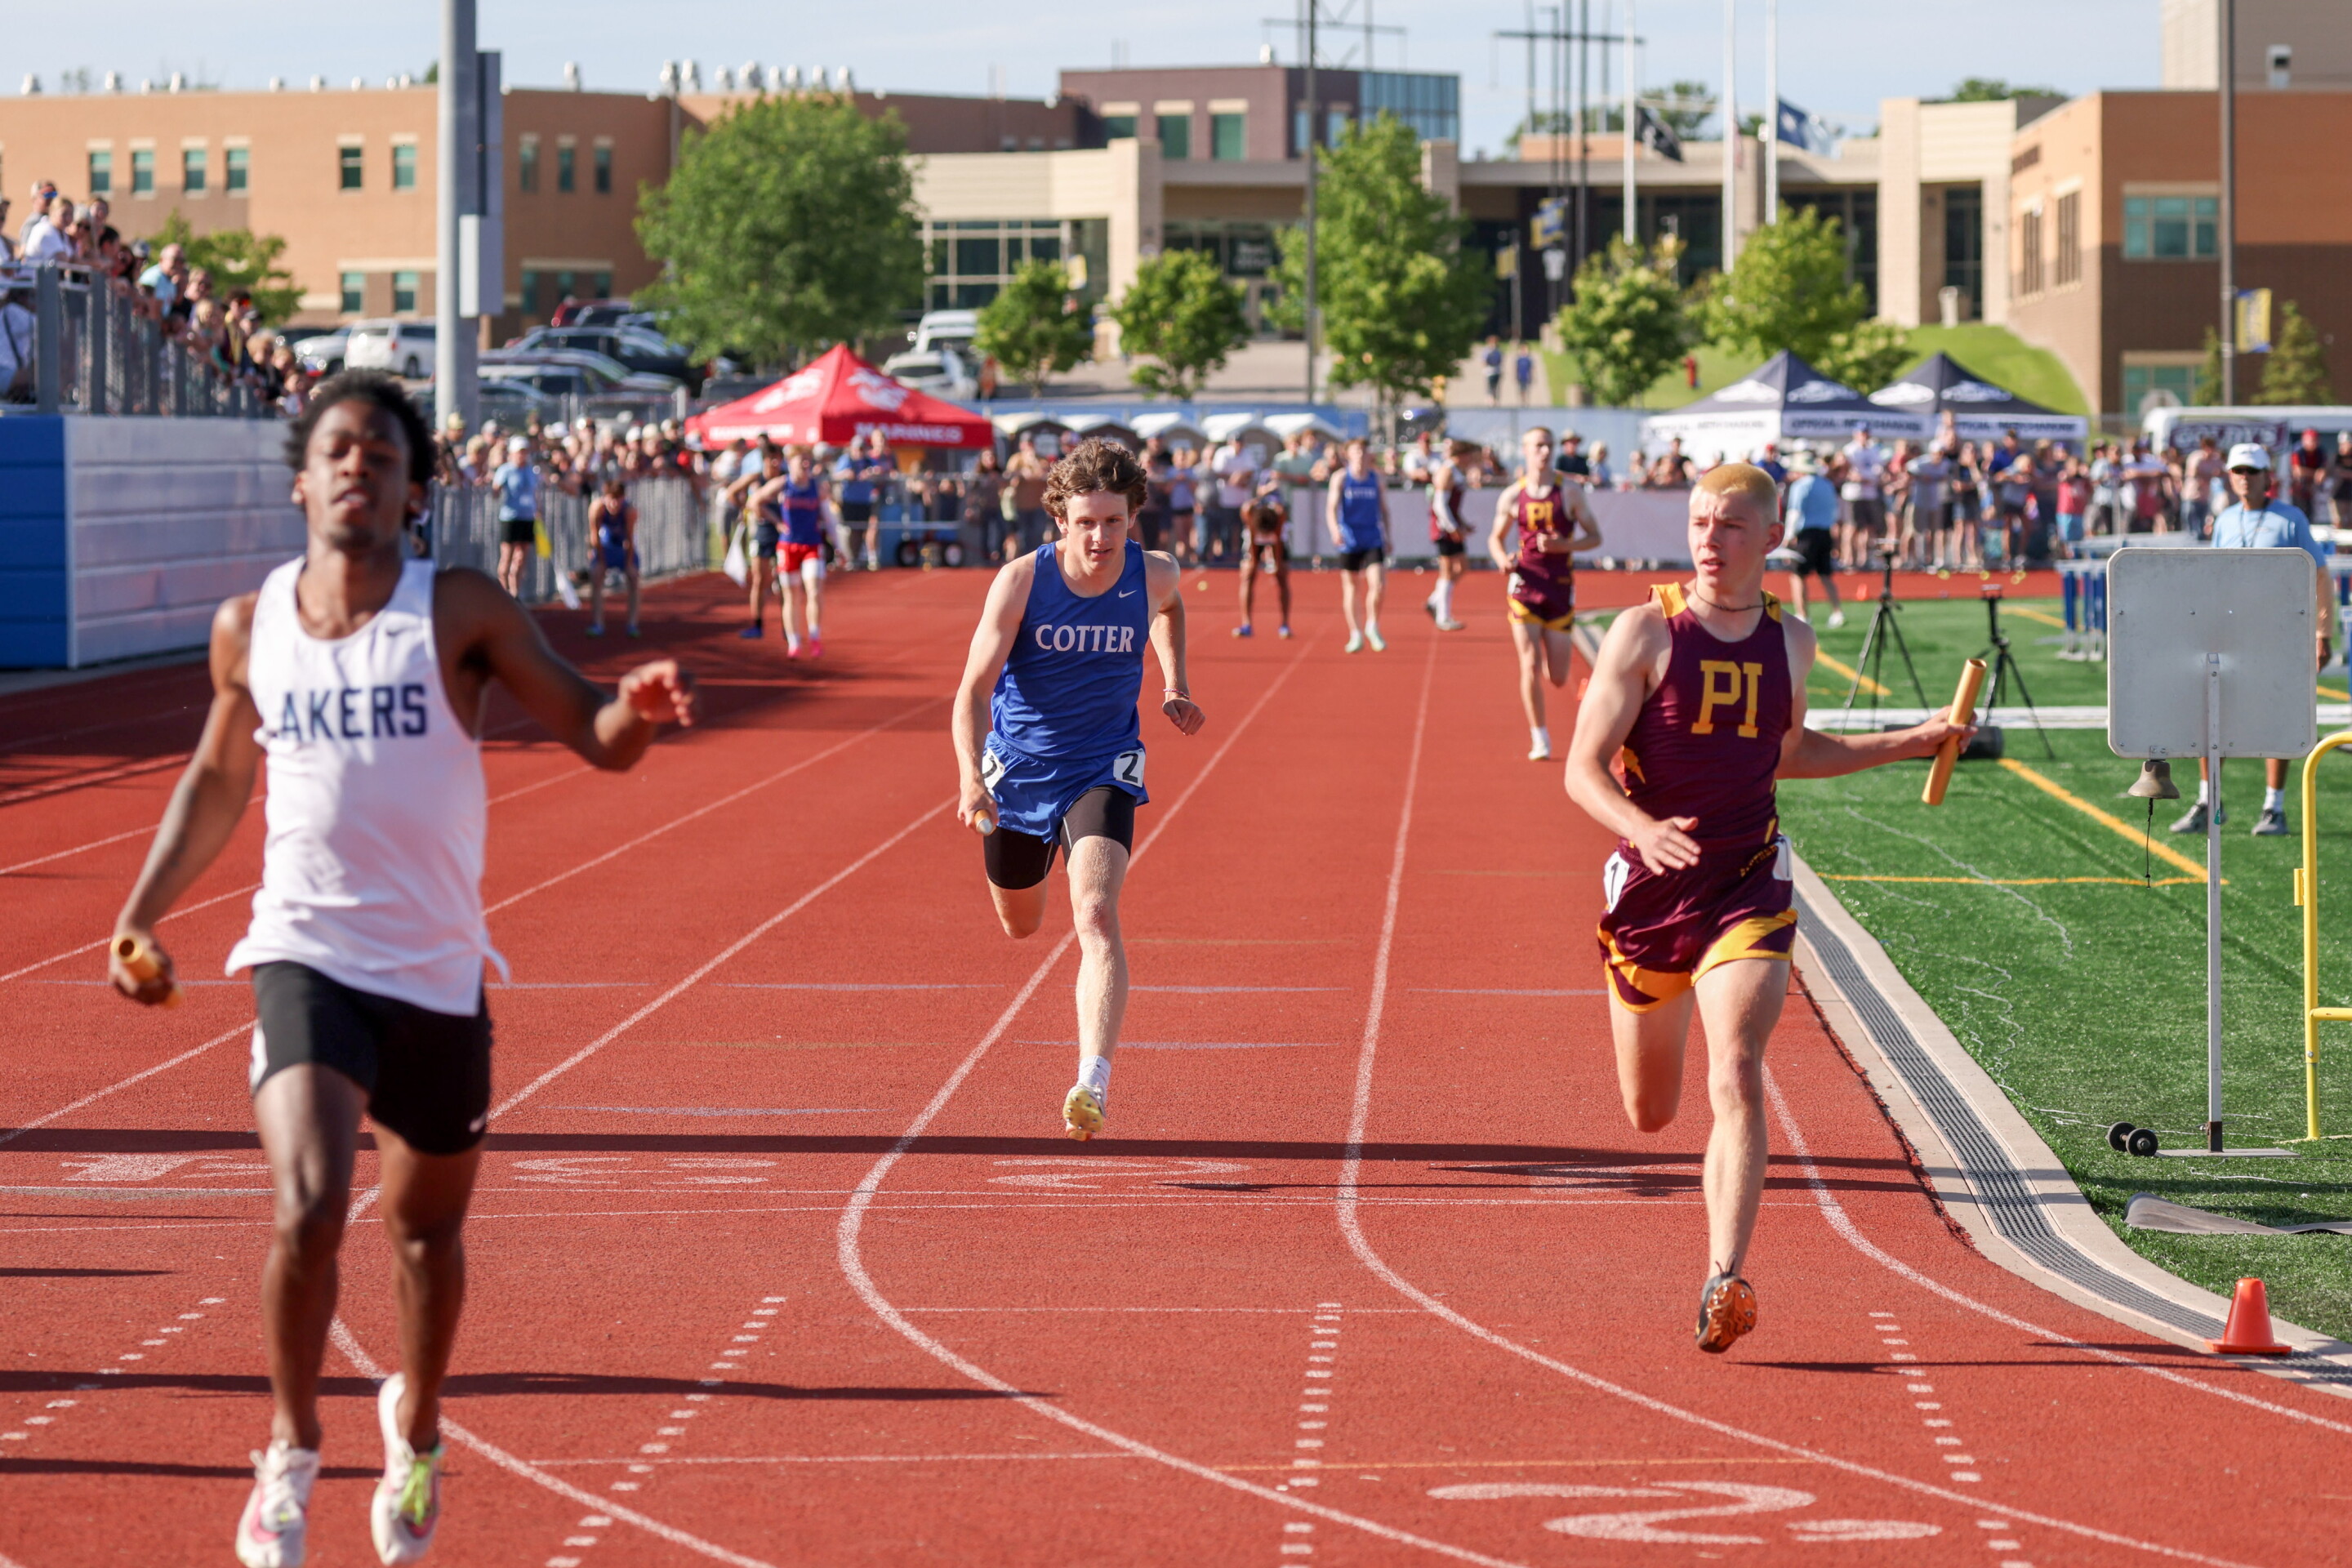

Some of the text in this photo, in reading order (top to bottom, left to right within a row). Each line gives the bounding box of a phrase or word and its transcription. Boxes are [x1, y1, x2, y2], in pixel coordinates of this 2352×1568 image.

[1526, 501, 1554, 530] PI
[1035, 624, 1134, 653] COTTER
[267, 684, 427, 741] AKERS
[1691, 660, 1762, 738] PI
[1120, 753, 1138, 783] 2
[1611, 862, 1619, 904] 1
[1427, 1482, 1943, 1544] 2
